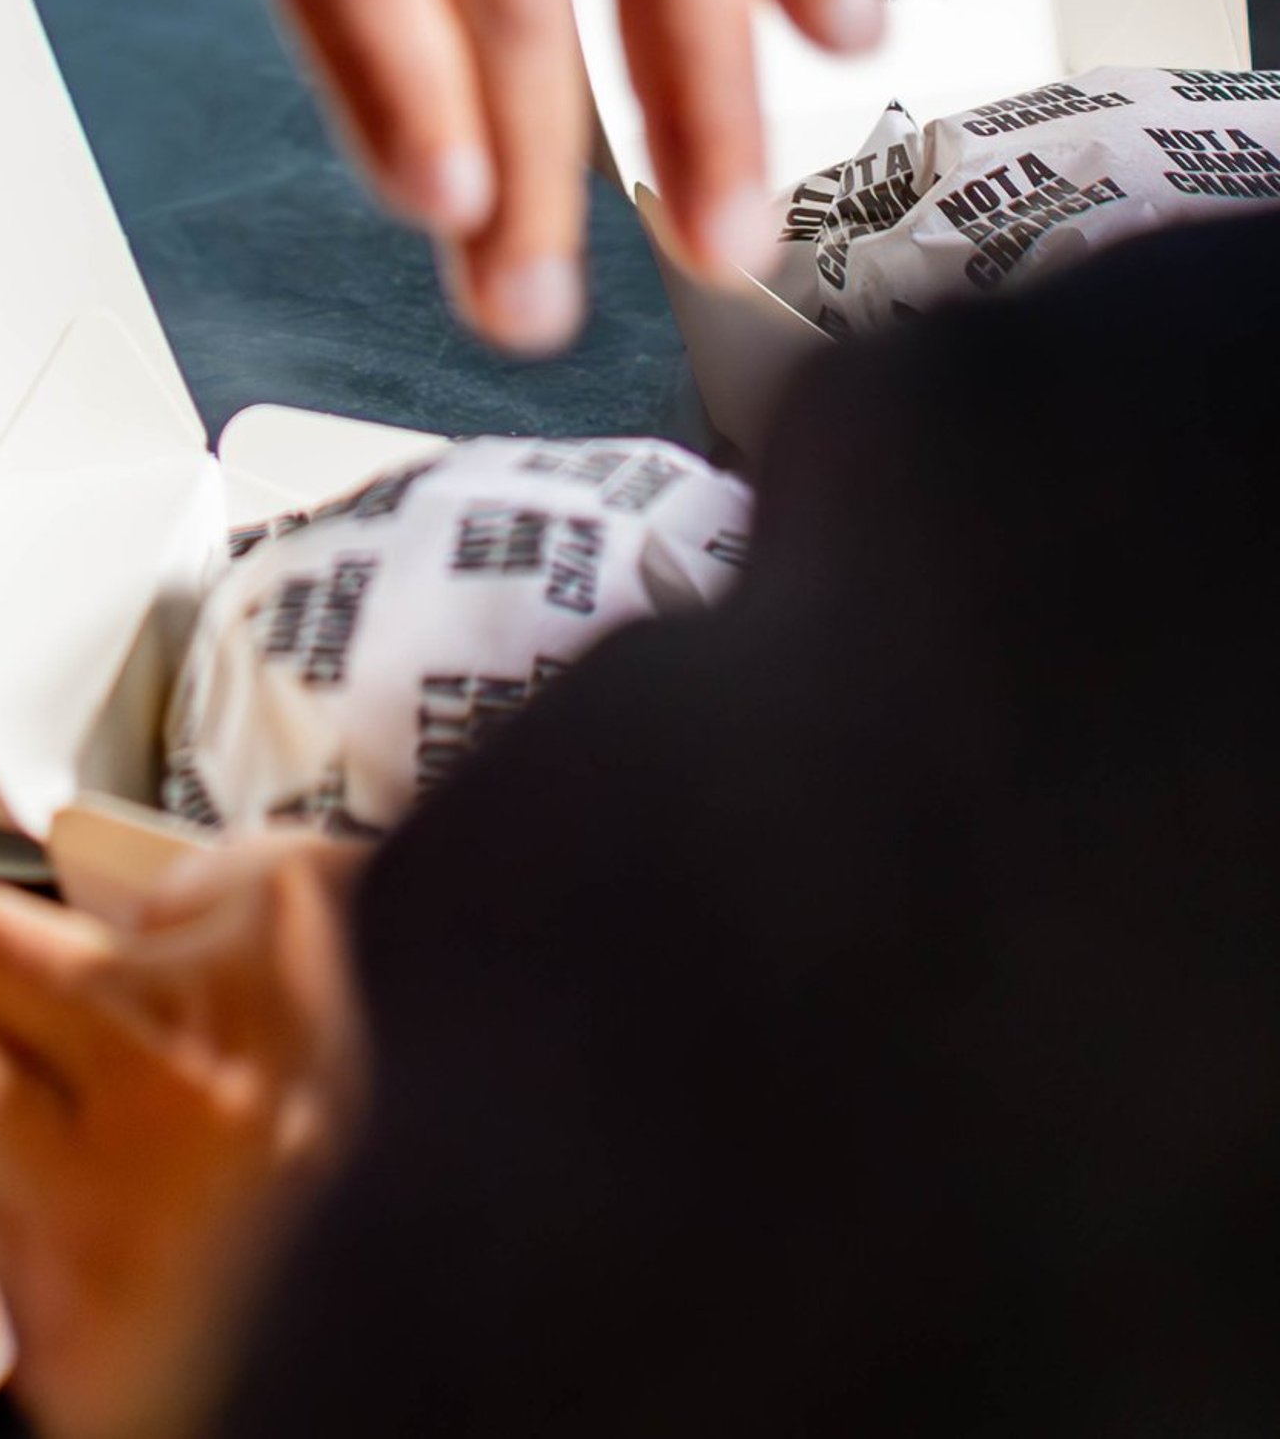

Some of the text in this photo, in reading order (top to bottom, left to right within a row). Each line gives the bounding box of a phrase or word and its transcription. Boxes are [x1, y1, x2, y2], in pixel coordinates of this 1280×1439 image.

[961, 91, 1136, 137] CHANCE!
[1142, 128, 1263, 151] NOT A
[1164, 149, 1280, 173] DAMN
[936, 151, 1058, 229] NOT A
[964, 176, 1129, 289] CHANCE!
